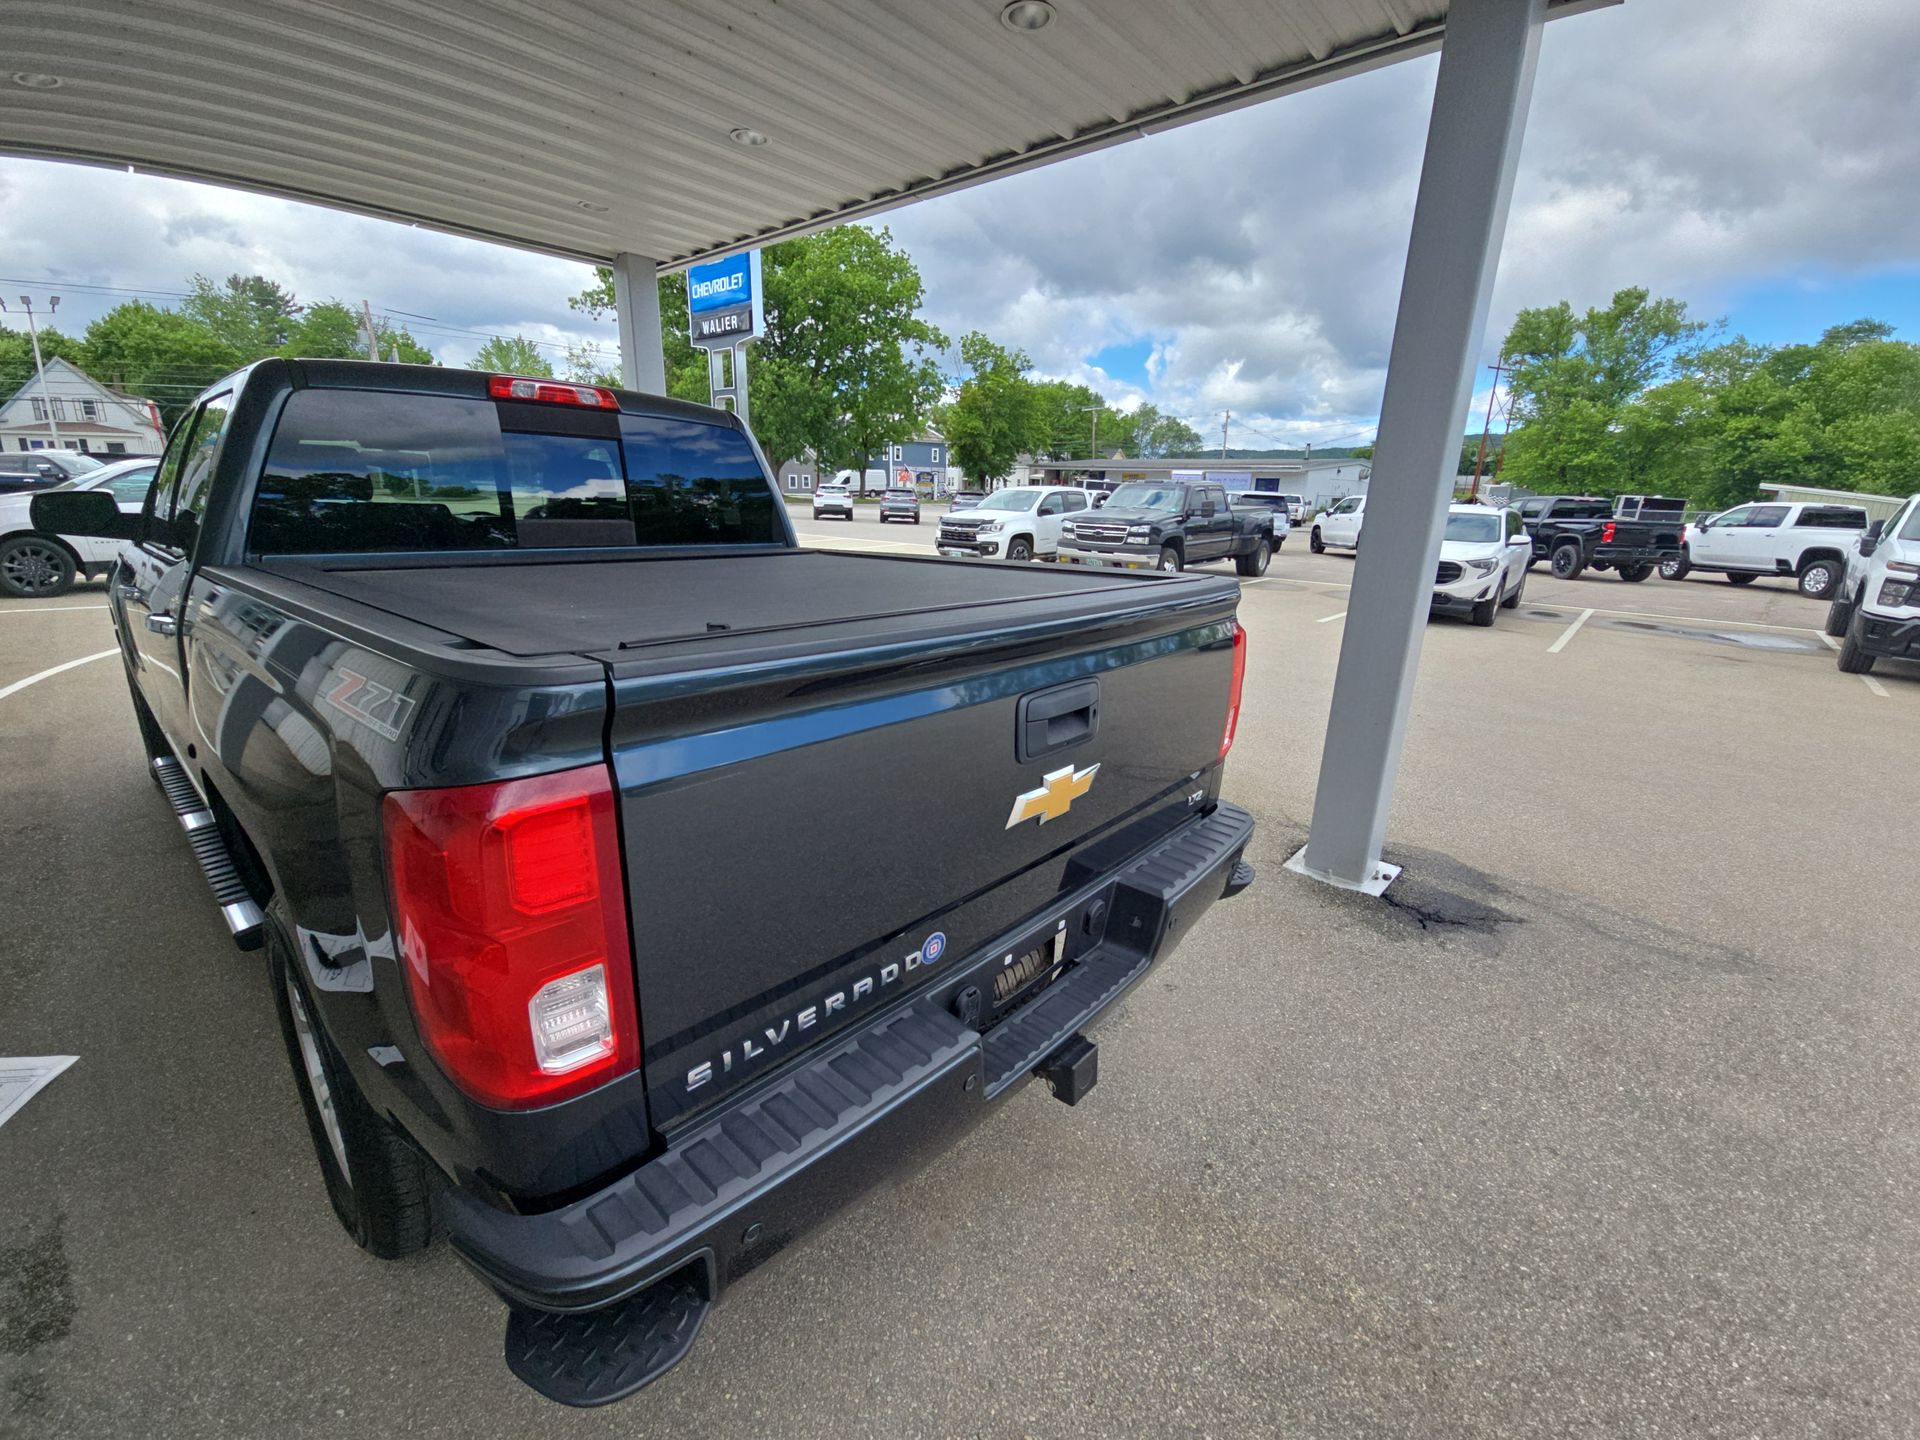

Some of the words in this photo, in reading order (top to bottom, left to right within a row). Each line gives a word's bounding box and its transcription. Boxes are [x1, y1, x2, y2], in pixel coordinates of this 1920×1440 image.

[691, 272, 744, 299] CHEVROLET
[702, 315, 738, 335] WALIER
[326, 667, 416, 742] Z71
[686, 950, 922, 1092] SILVERADO
